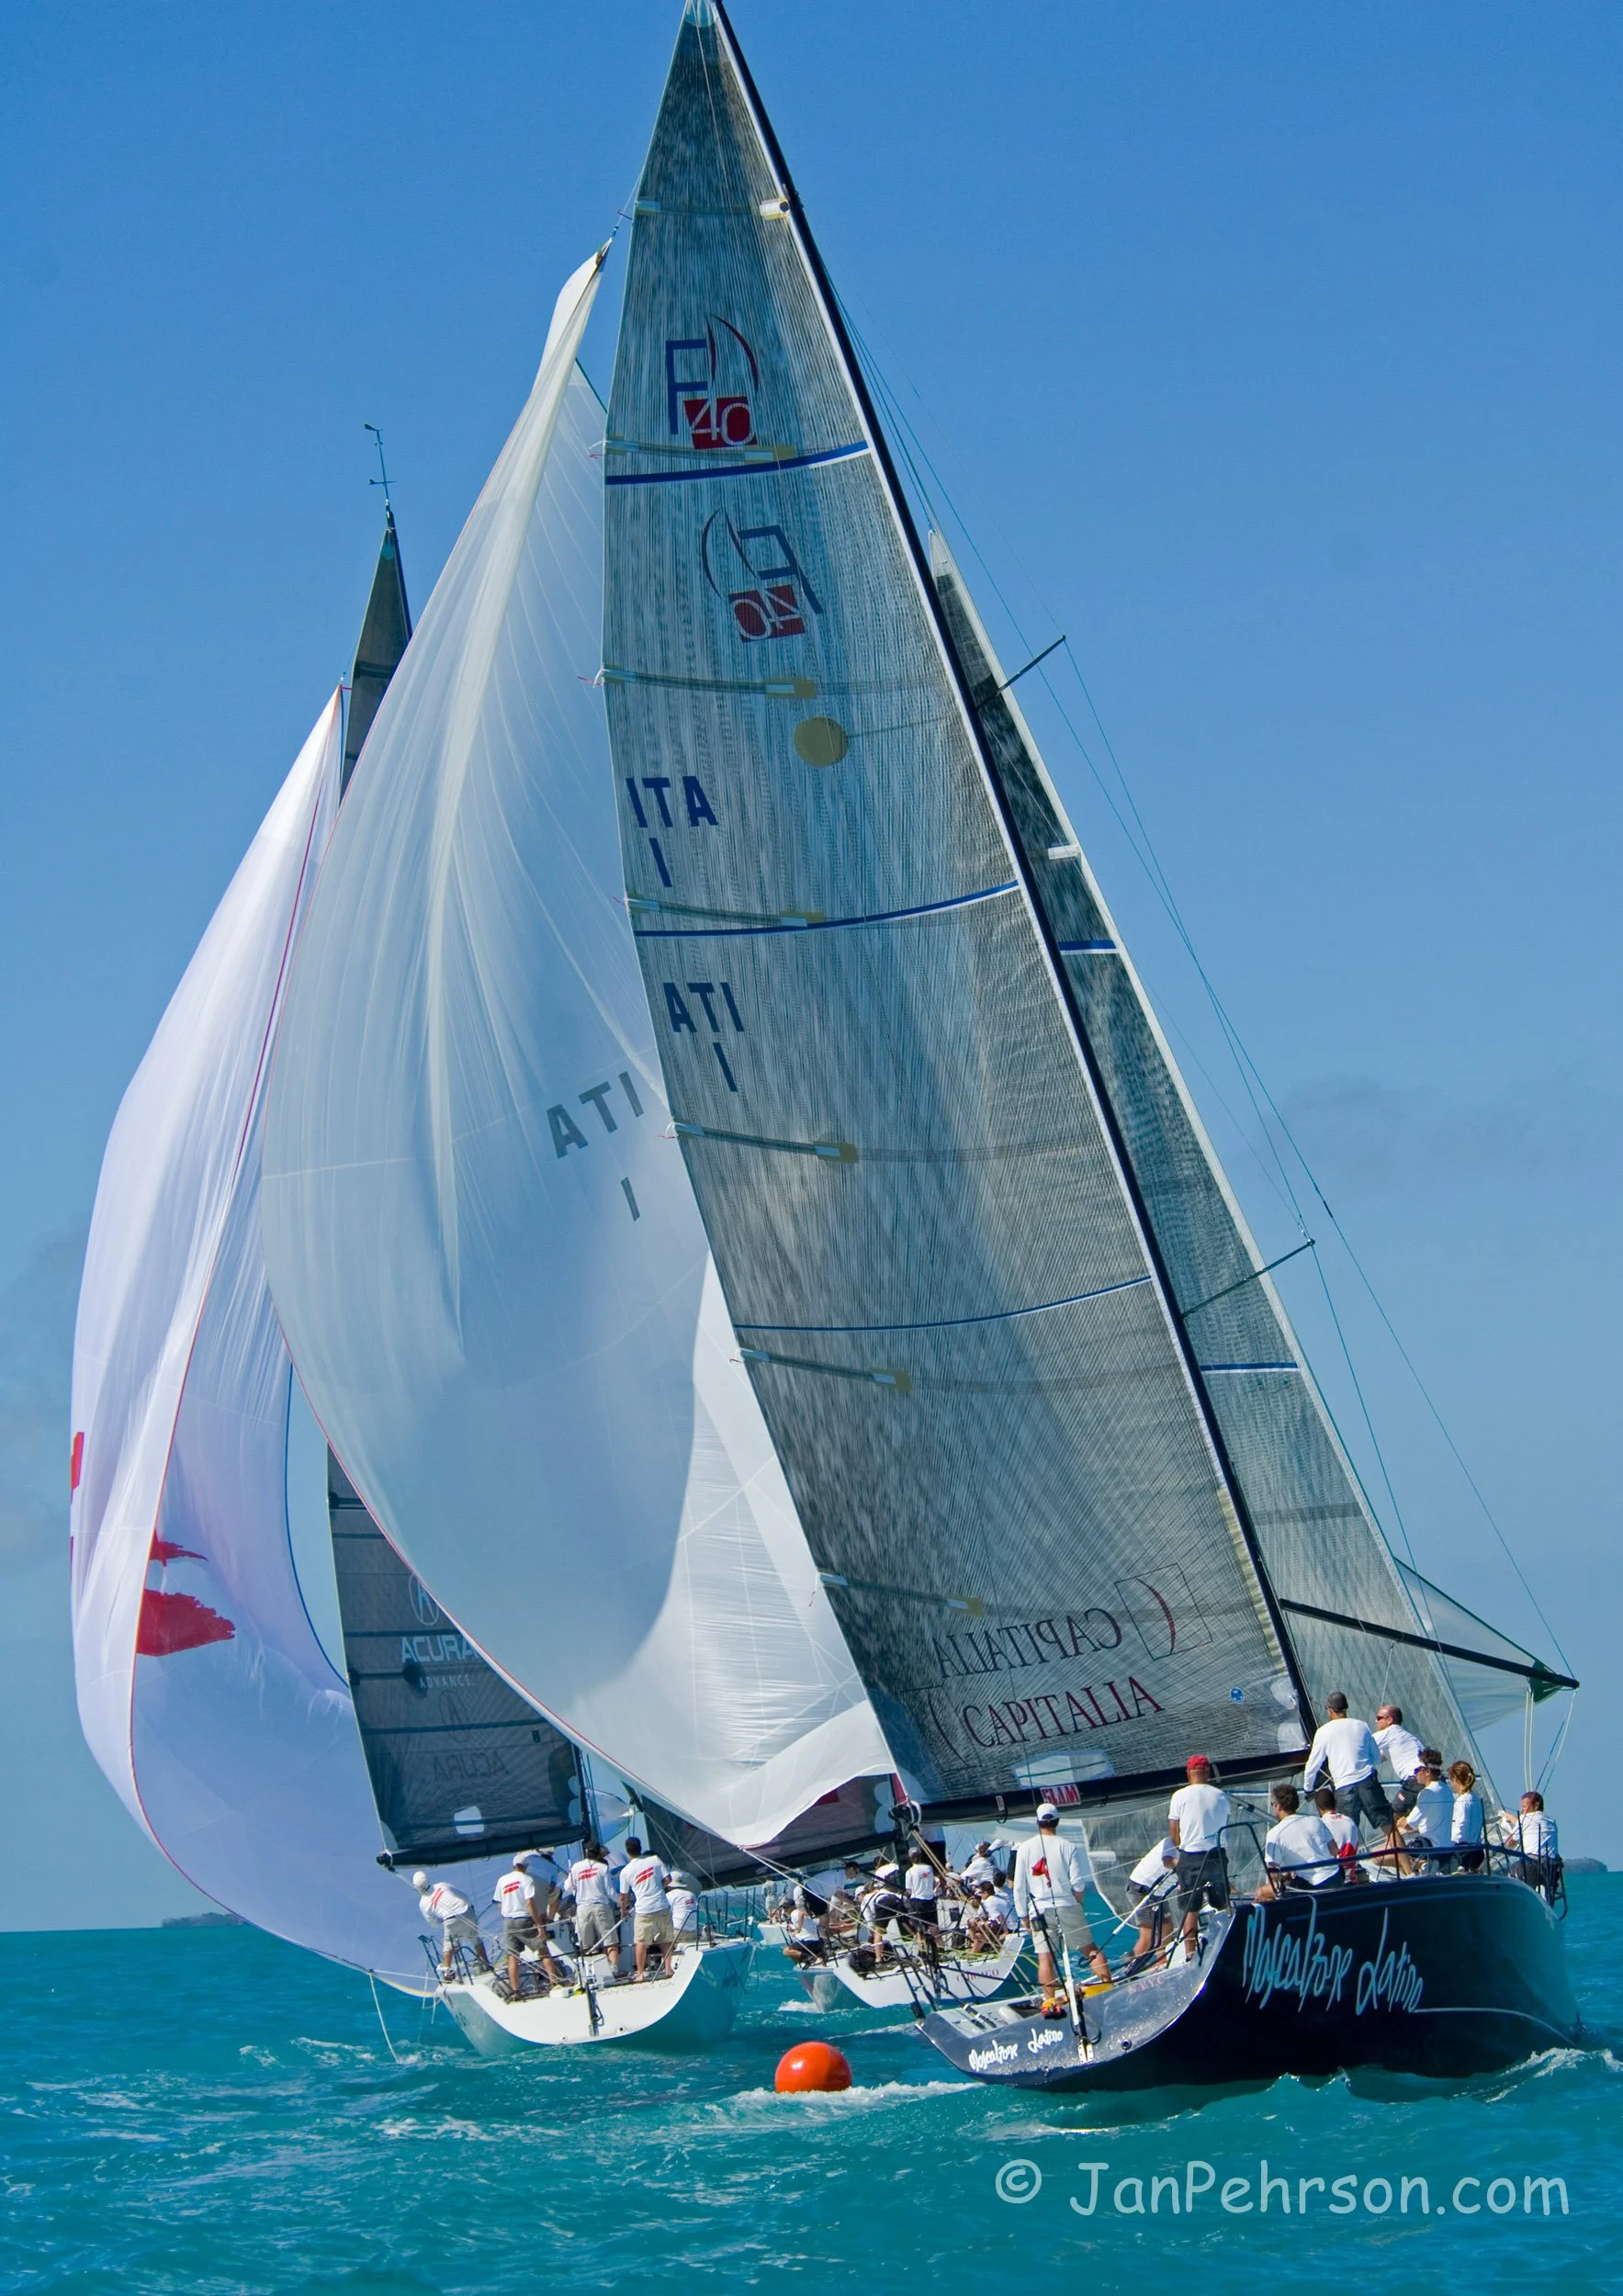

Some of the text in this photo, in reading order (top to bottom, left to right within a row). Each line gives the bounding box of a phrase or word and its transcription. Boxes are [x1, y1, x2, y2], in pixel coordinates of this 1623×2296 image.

[626, 775, 719, 827] ITA
[400, 1634, 479, 1663] ACURA
[962, 1676, 1167, 1748] CAPITALIA
